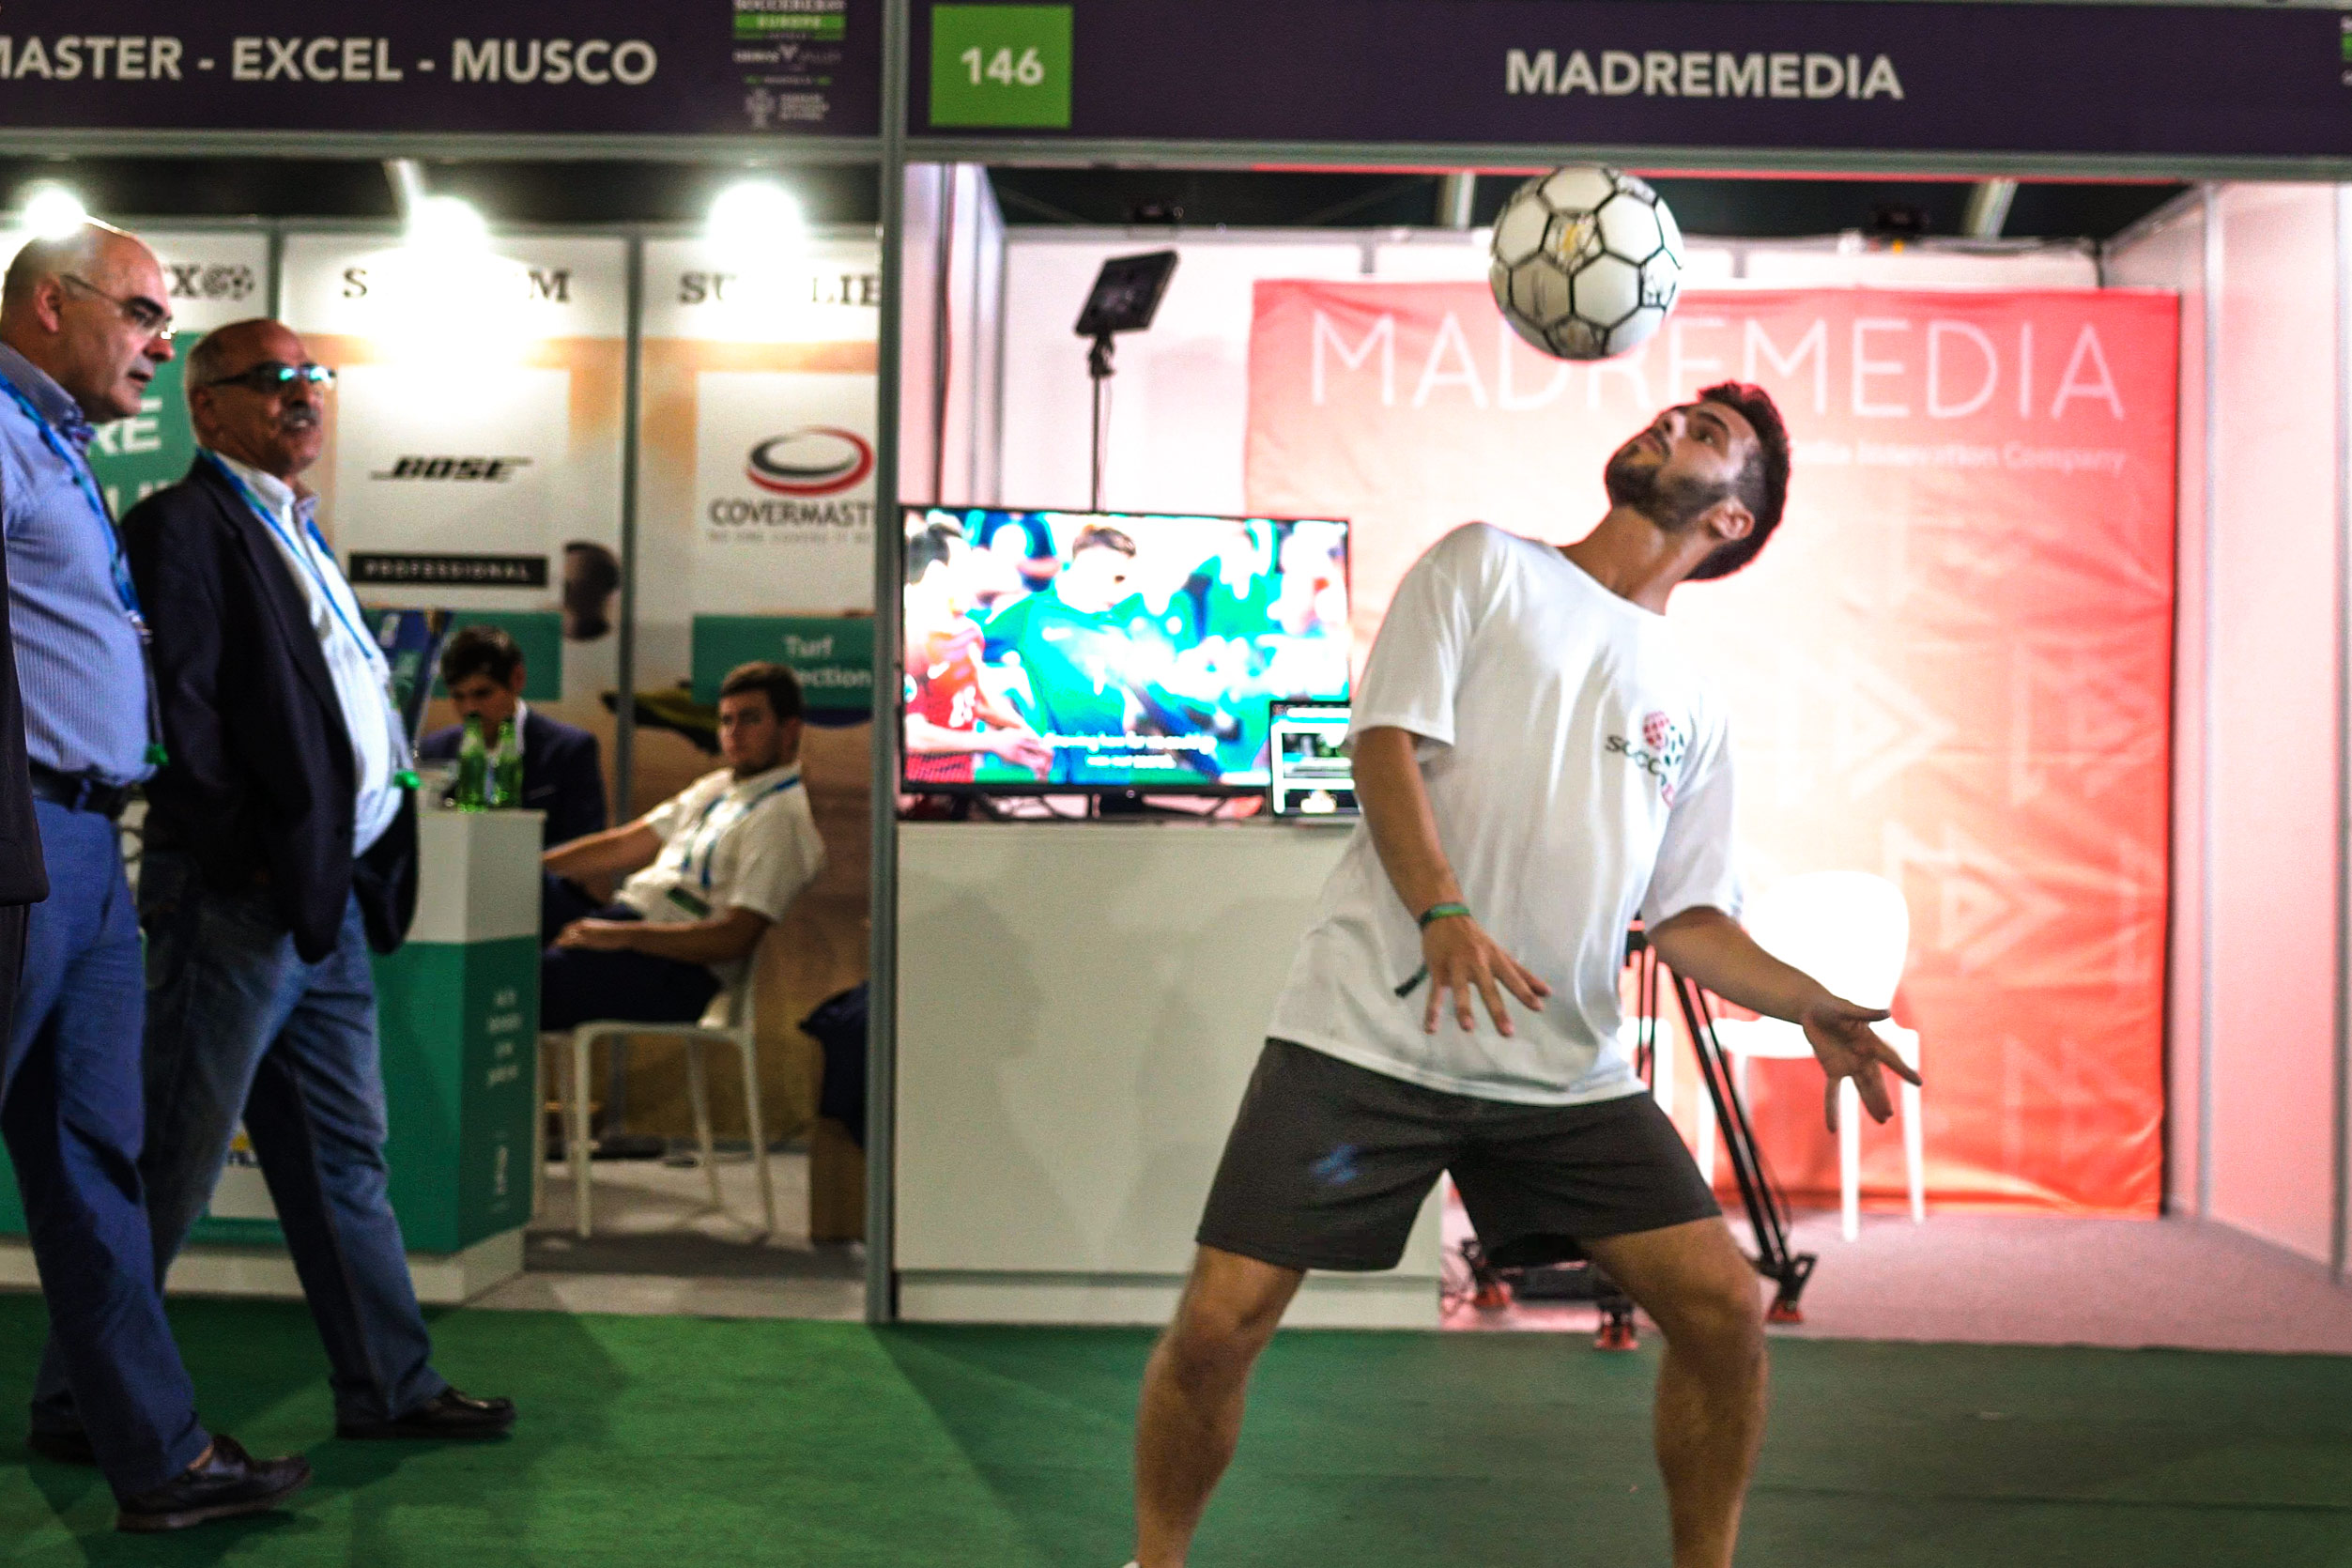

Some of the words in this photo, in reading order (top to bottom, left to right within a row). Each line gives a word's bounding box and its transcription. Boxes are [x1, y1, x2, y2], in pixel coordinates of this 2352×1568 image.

[0, 35, 183, 81] ASTER
[197, 56, 216, 71] -
[232, 36, 404, 82] EXCEL
[417, 58, 436, 72] -
[452, 38, 658, 85] MUSCO
[961, 46, 1045, 85] 146
[1504, 48, 1905, 100] MADREMEDIA
[370, 455, 532, 483] BOSE
[362, 559, 529, 582] PROFESSIONAL
[783, 635, 834, 658] Turf
[794, 667, 873, 687] ection
